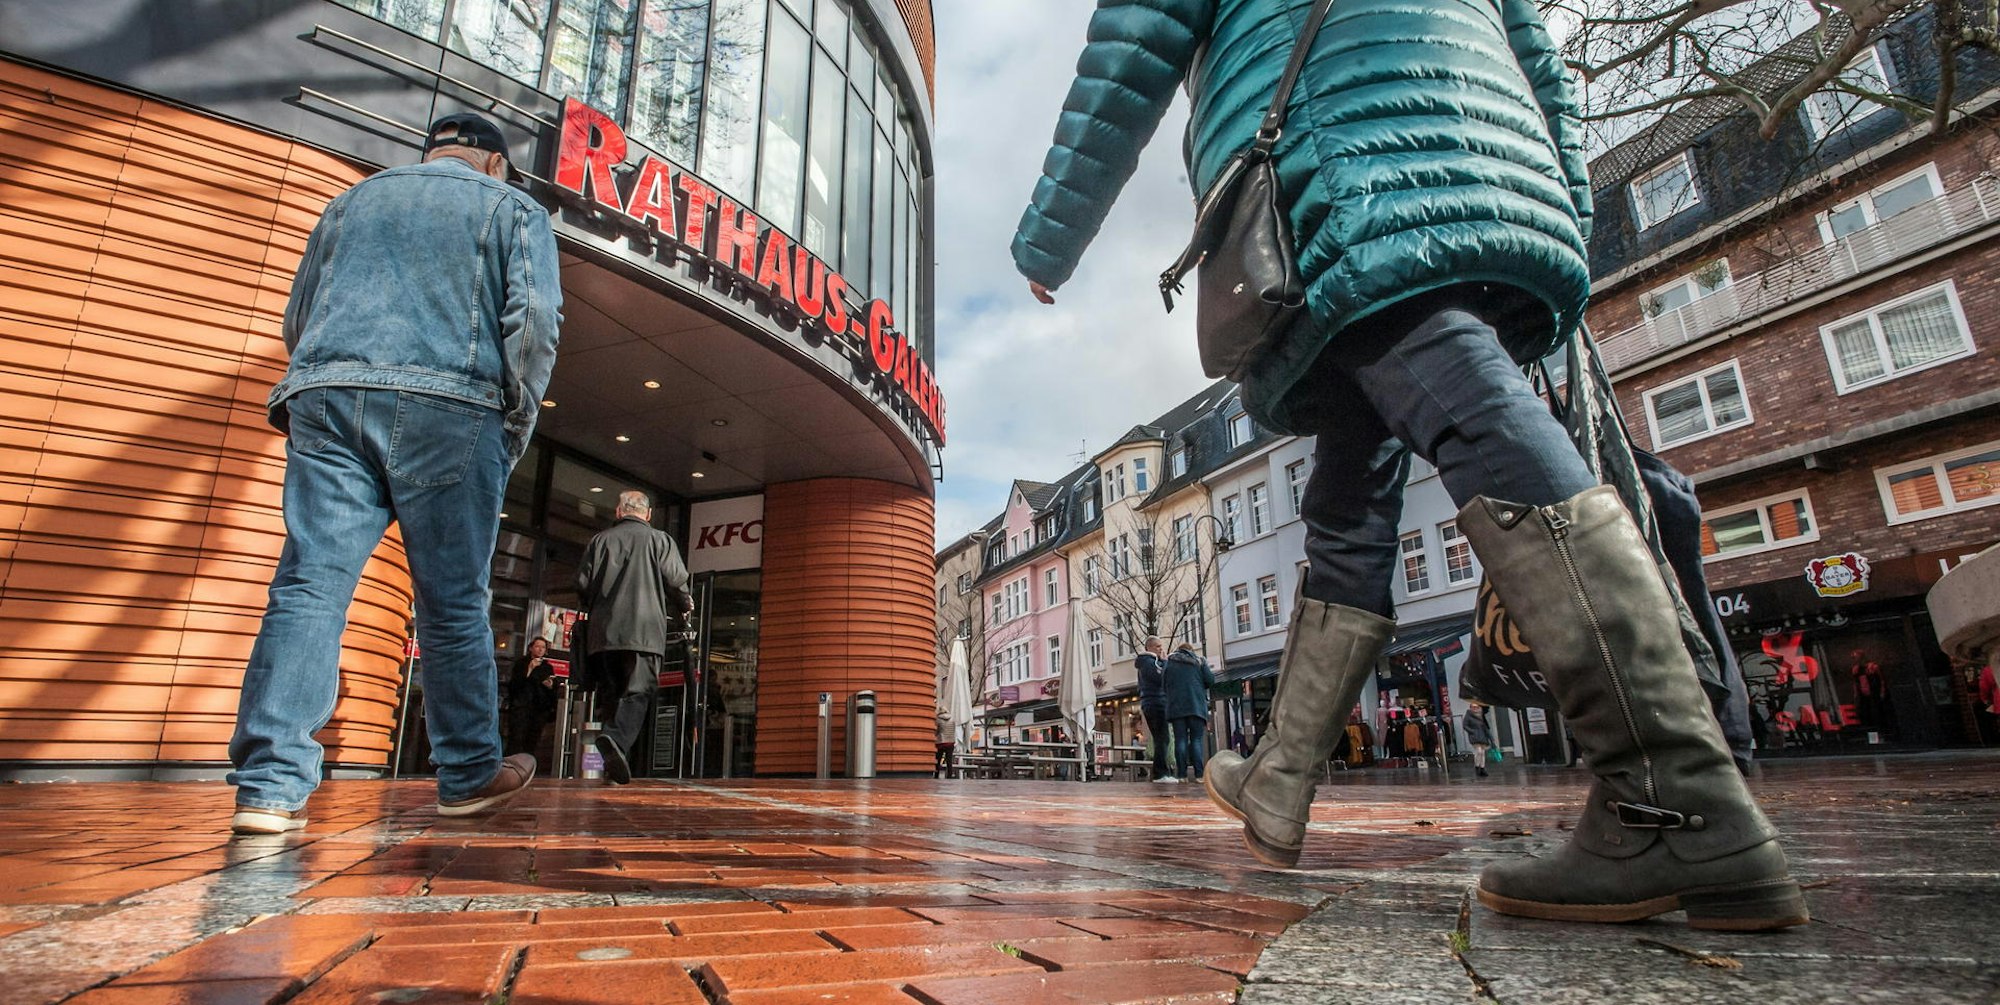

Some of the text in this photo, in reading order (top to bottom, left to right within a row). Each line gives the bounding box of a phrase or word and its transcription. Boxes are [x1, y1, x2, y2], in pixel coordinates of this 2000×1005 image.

[553, 96, 947, 442] RATHAUS-GALERIE
[695, 519, 764, 550] KFC
[1715, 592, 1750, 618] 04
[1775, 703, 1862, 732] SALE
